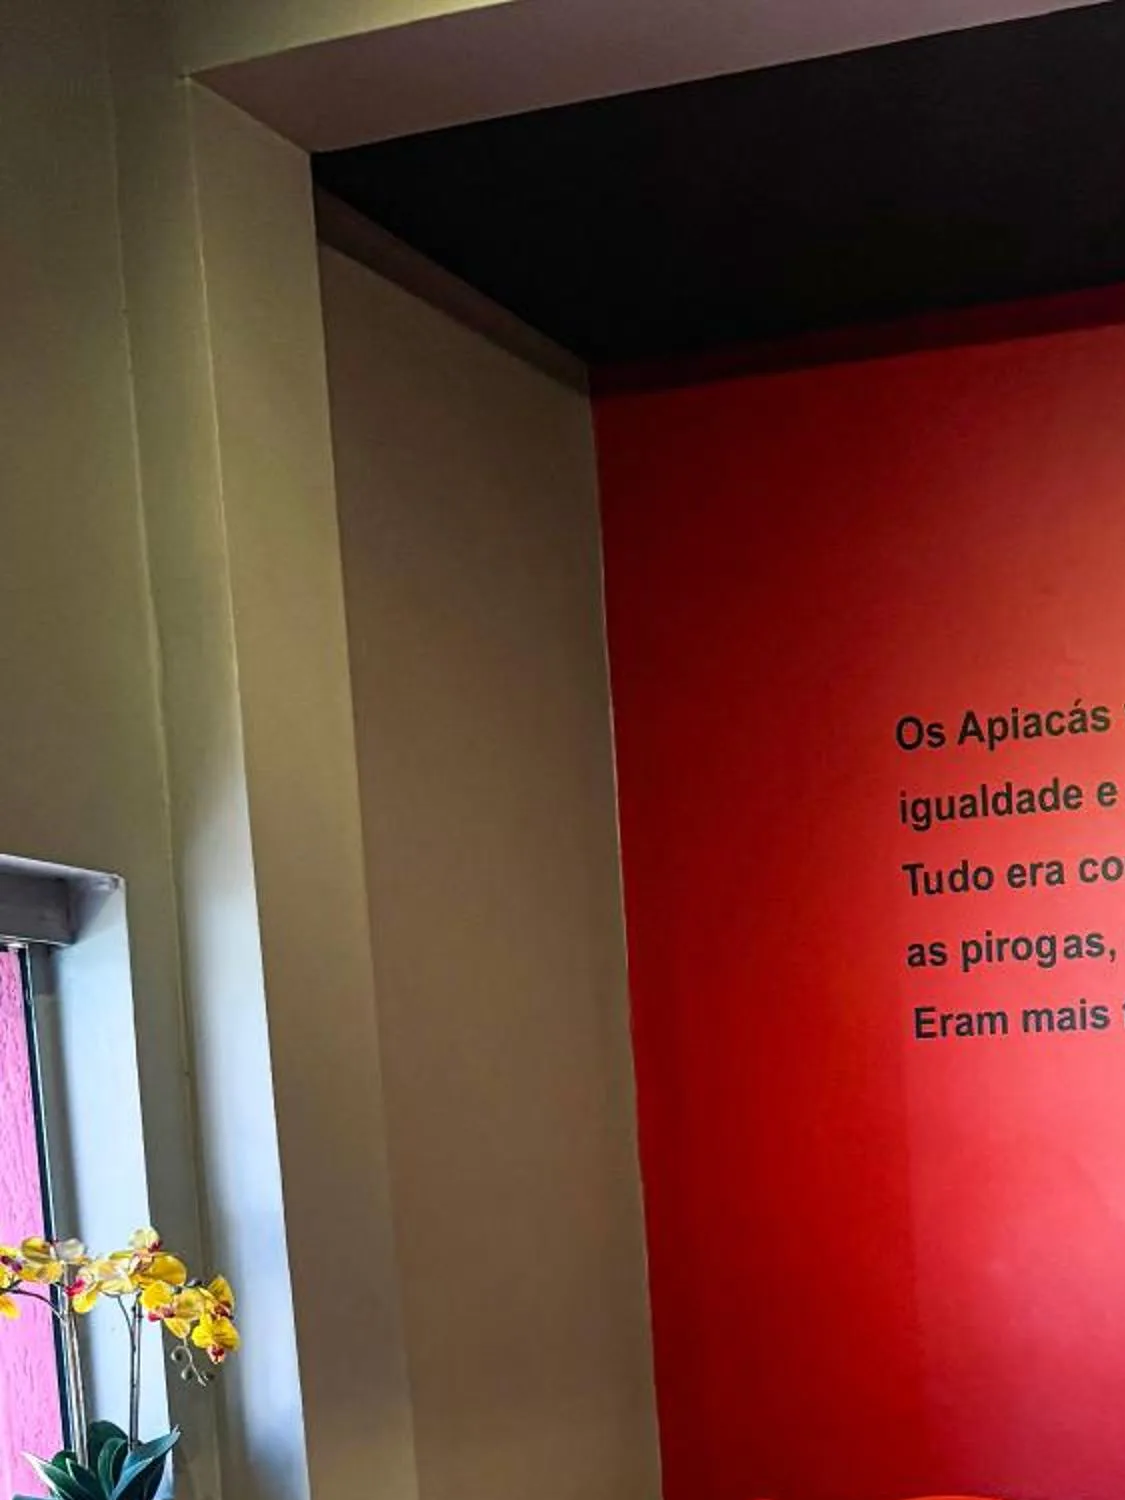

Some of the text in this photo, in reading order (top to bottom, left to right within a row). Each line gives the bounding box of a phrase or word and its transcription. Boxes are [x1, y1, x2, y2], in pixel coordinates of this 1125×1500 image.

[895, 715, 947, 752] Os
[957, 698, 1111, 752] Apiacás
[899, 776, 1084, 832] igualdade
[1095, 781, 1119, 809] e
[901, 859, 995, 897] Tudo
[1005, 859, 1066, 889] era
[906, 941, 949, 969] as
[960, 929, 1117, 974] pirogas,
[913, 1005, 1009, 1040] Eram
[1021, 997, 1111, 1034] mais
